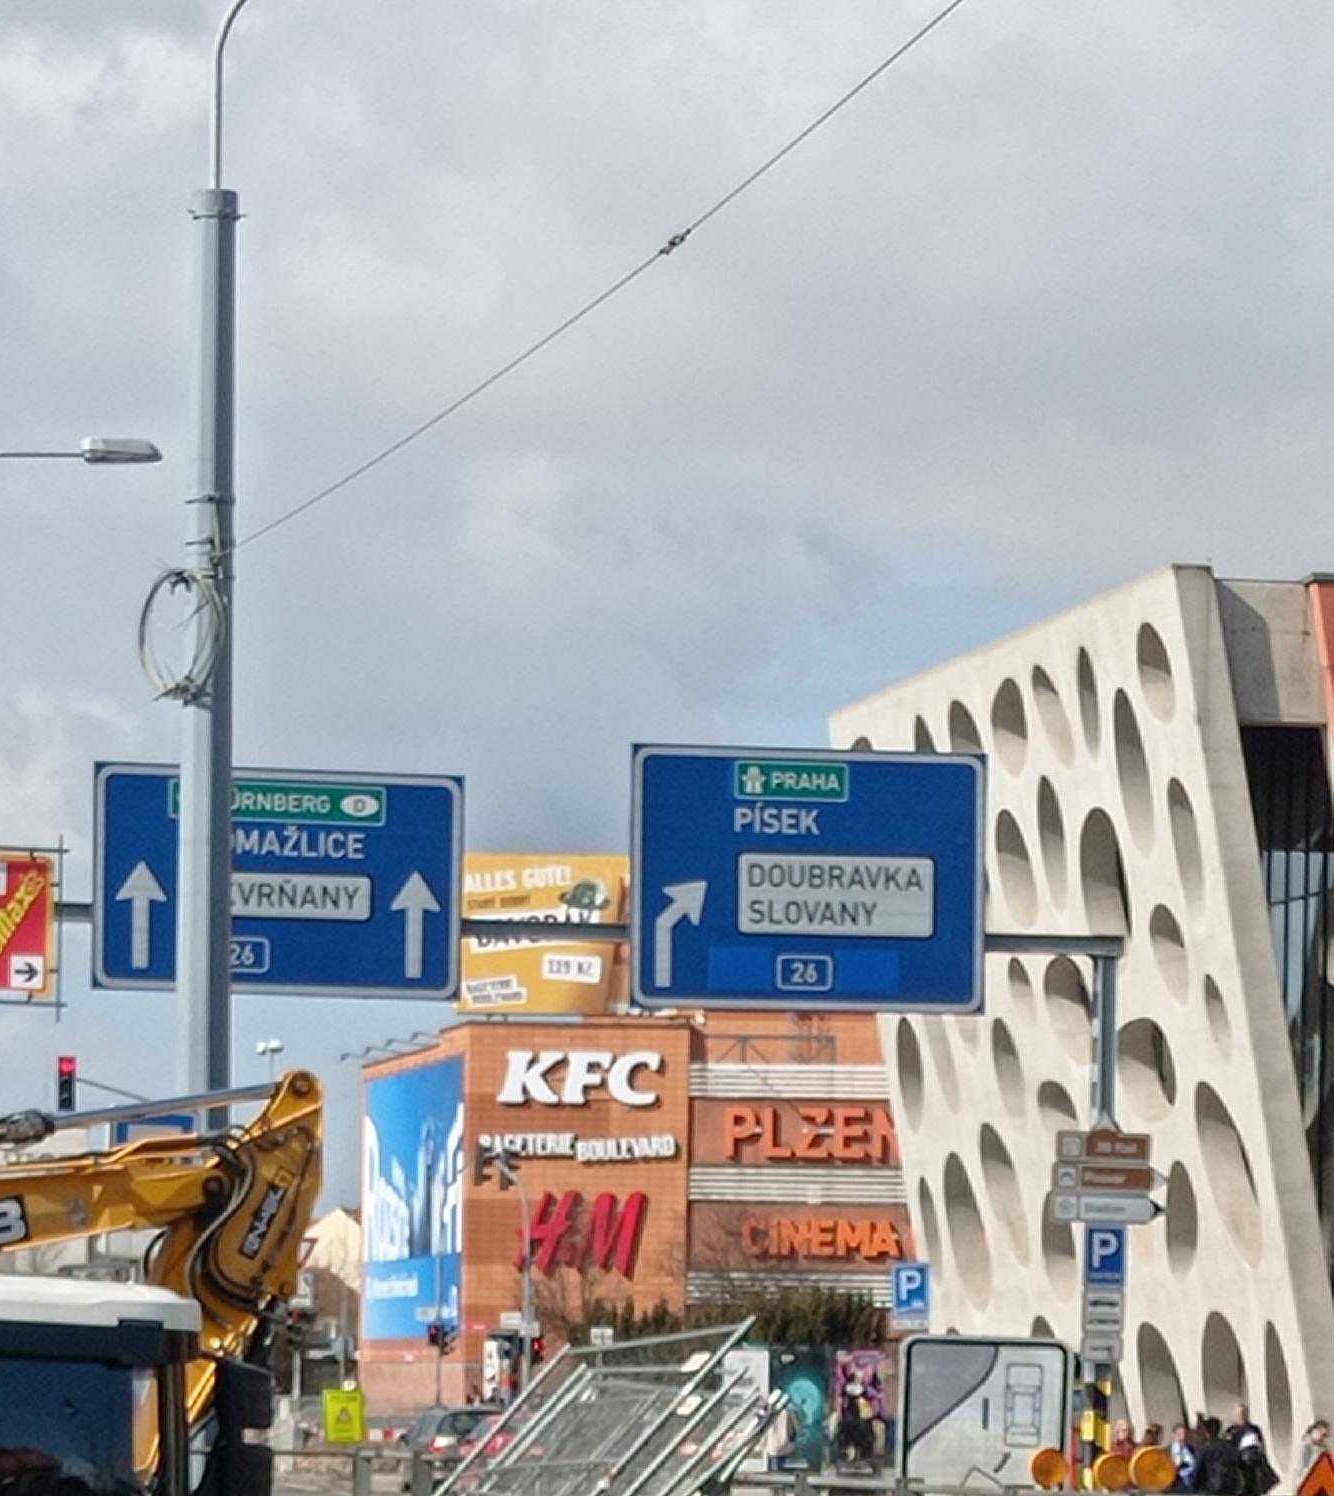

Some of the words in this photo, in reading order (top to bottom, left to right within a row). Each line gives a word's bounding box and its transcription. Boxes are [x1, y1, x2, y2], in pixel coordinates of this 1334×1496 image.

[770, 772, 841, 792] PRAHA
[733, 802, 820, 835] PÍSEK
[231, 825, 366, 859] MAŽLICE
[747, 862, 924, 892] DOUBRAVKA
[231, 879, 361, 911] VRŇANY
[748, 900, 878, 927] SLOVANY
[230, 944, 256, 967] 26
[789, 963, 818, 985] 26
[497, 1049, 662, 1107] KFC
[742, 1217, 900, 1257] CINEMA
[1091, 1231, 1120, 1268] P
[898, 1270, 922, 1301] P
